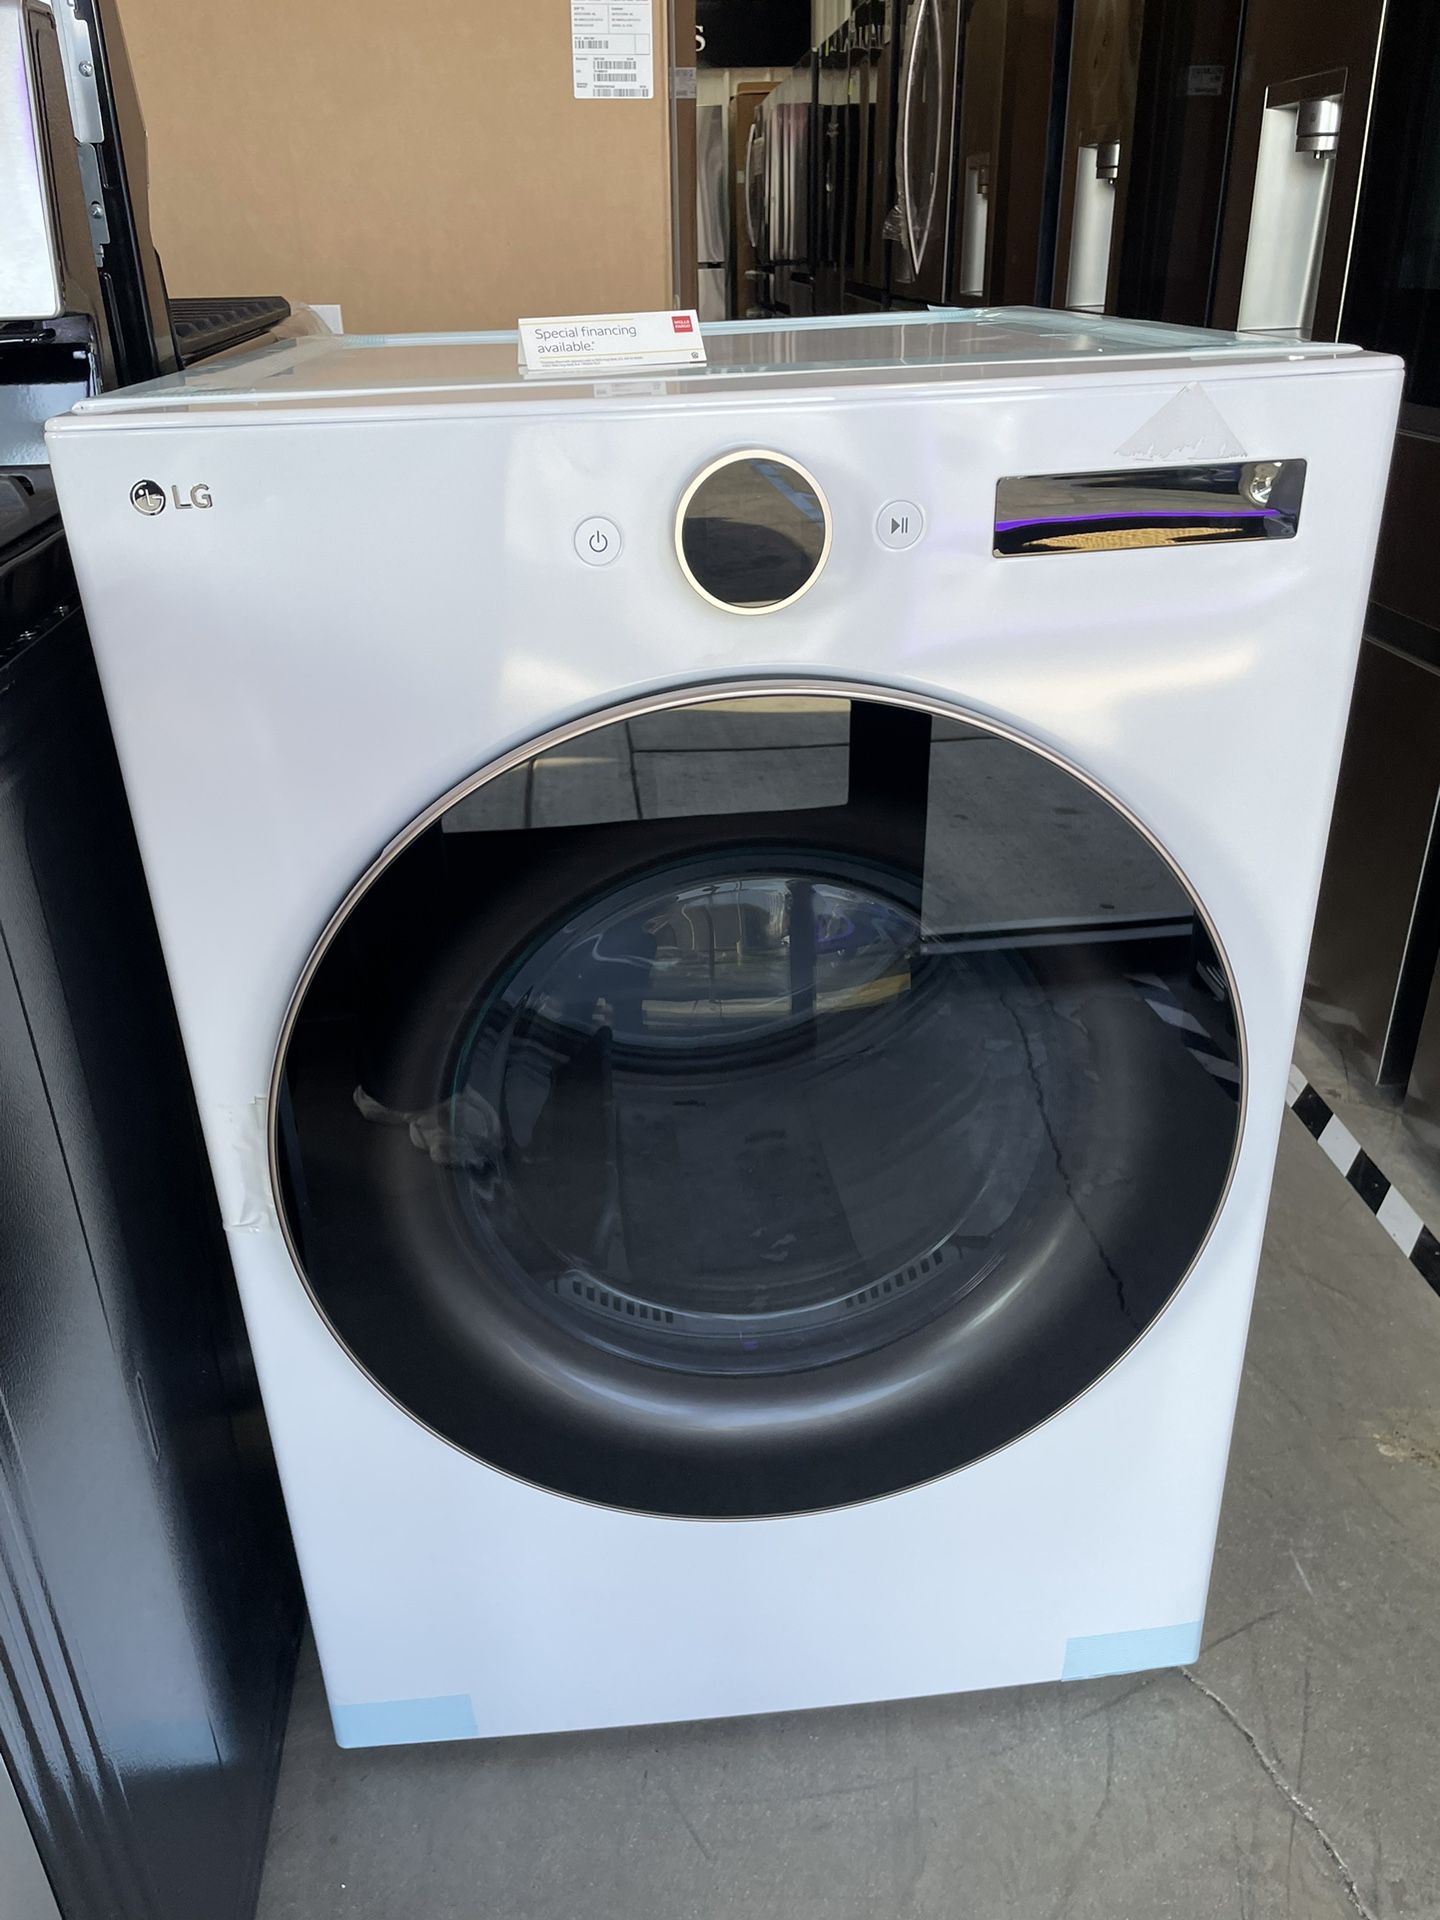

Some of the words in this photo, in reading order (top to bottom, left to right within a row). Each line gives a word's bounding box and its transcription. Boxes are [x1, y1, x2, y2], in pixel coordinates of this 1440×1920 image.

[534, 325, 579, 341] Special
[581, 324, 637, 338] financing
[171, 483, 213, 509] LG
